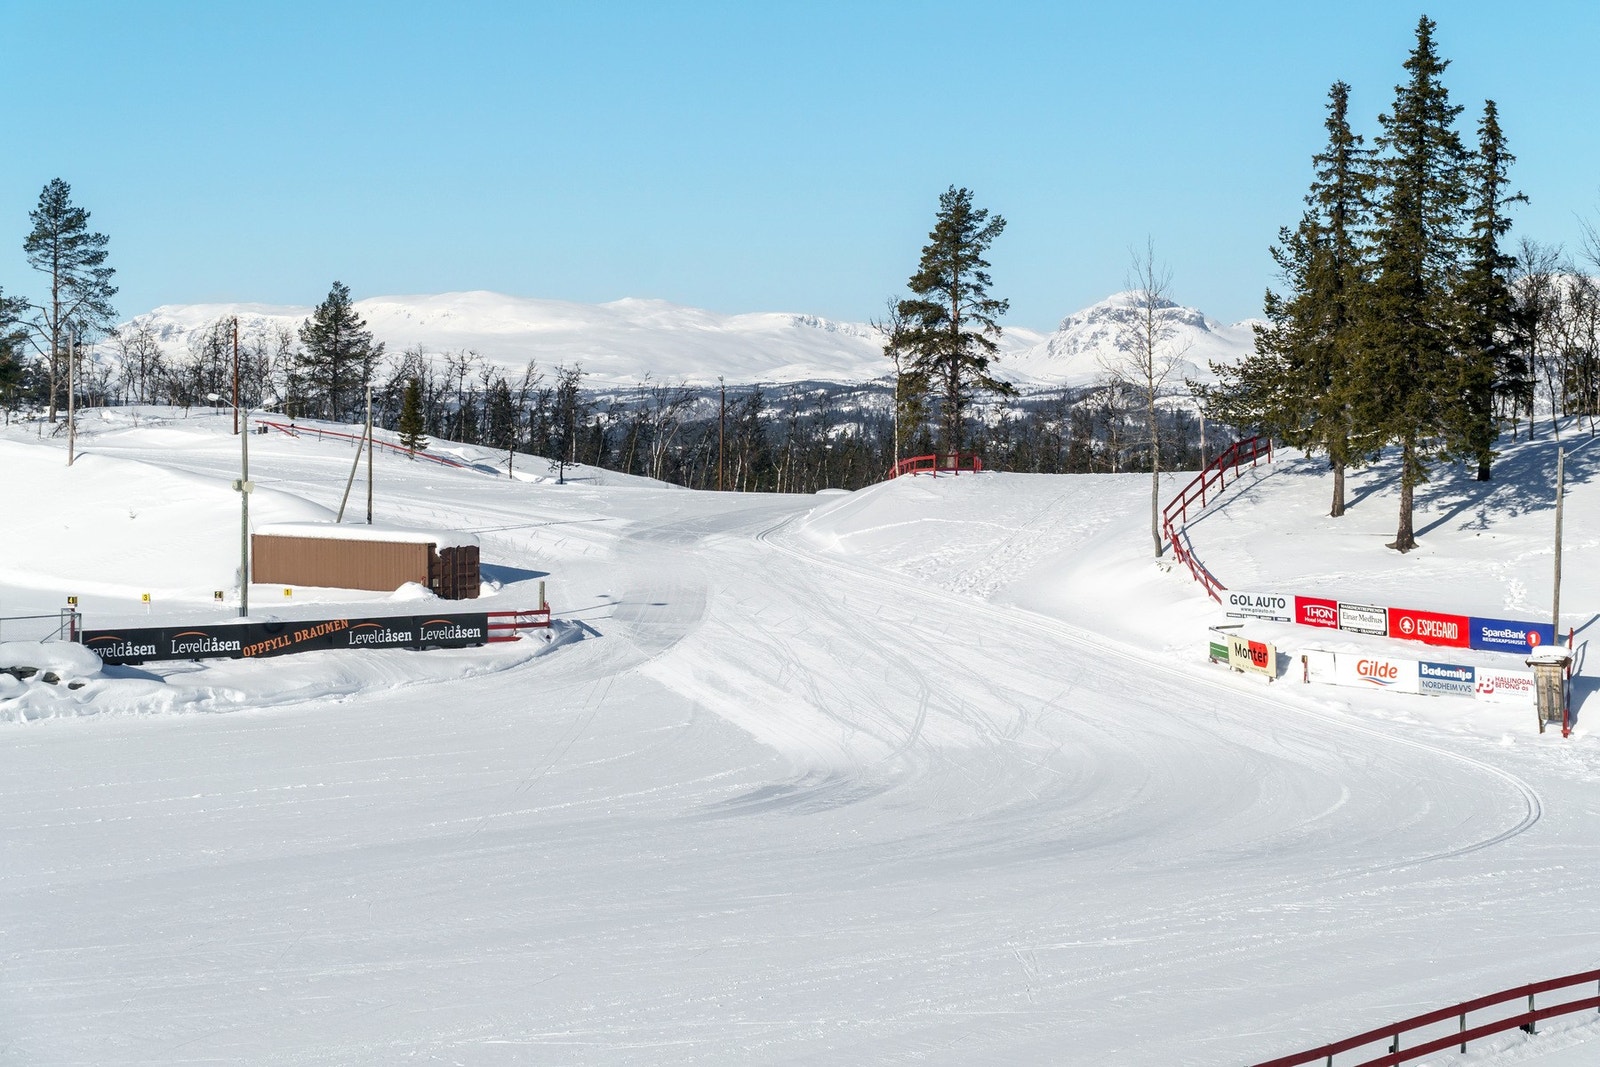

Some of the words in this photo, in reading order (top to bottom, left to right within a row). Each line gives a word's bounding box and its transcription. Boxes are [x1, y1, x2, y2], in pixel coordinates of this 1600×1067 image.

[1230, 594, 1253, 606] GOL
[1256, 596, 1286, 609] AUTO
[1303, 605, 1336, 619] THON
[1343, 611, 1358, 621] Einar
[1359, 614, 1383, 624] Medhus
[349, 629, 412, 645] Leveldåsen
[420, 625, 481, 641] Leveldåsen
[1417, 619, 1458, 639] ESPEGARD
[1482, 627, 1526, 639] SpareBank
[1530, 633, 1537, 644] 1
[171, 638, 241, 654] Leveldåsen
[243, 635, 291, 657] OPPFYLL
[294, 620, 349, 642] DRAUMEN
[86, 641, 157, 658] eveldåsen
[1357, 660, 1398, 679] Gilde
[1421, 664, 1472, 680] Bademiljø
[1422, 681, 1459, 690] NORDHEIM
[1459, 685, 1472, 693] VVS
[1495, 676, 1534, 686] HALLINGDAL
[1495, 682, 1520, 690] BETONG
